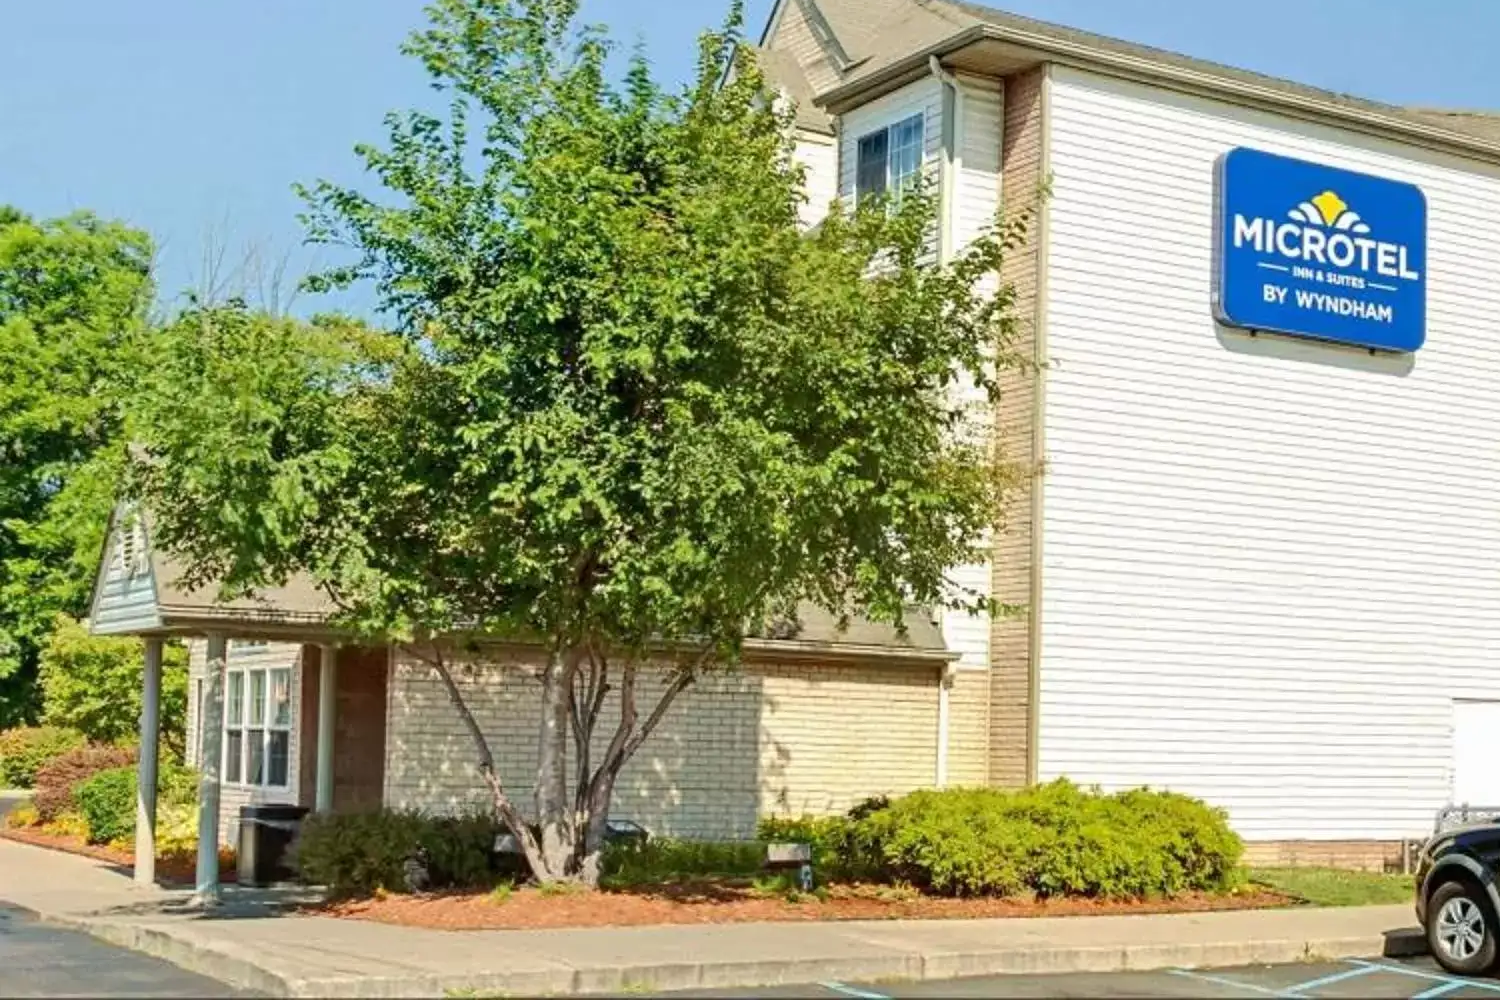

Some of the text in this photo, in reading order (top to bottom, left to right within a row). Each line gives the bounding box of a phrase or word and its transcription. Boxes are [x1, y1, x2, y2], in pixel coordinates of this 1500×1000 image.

[1234, 214, 1418, 280] MICROTEL
[1292, 265, 1365, 288] INN & SUITES
[1263, 284, 1392, 323] BY WYNDHAM
